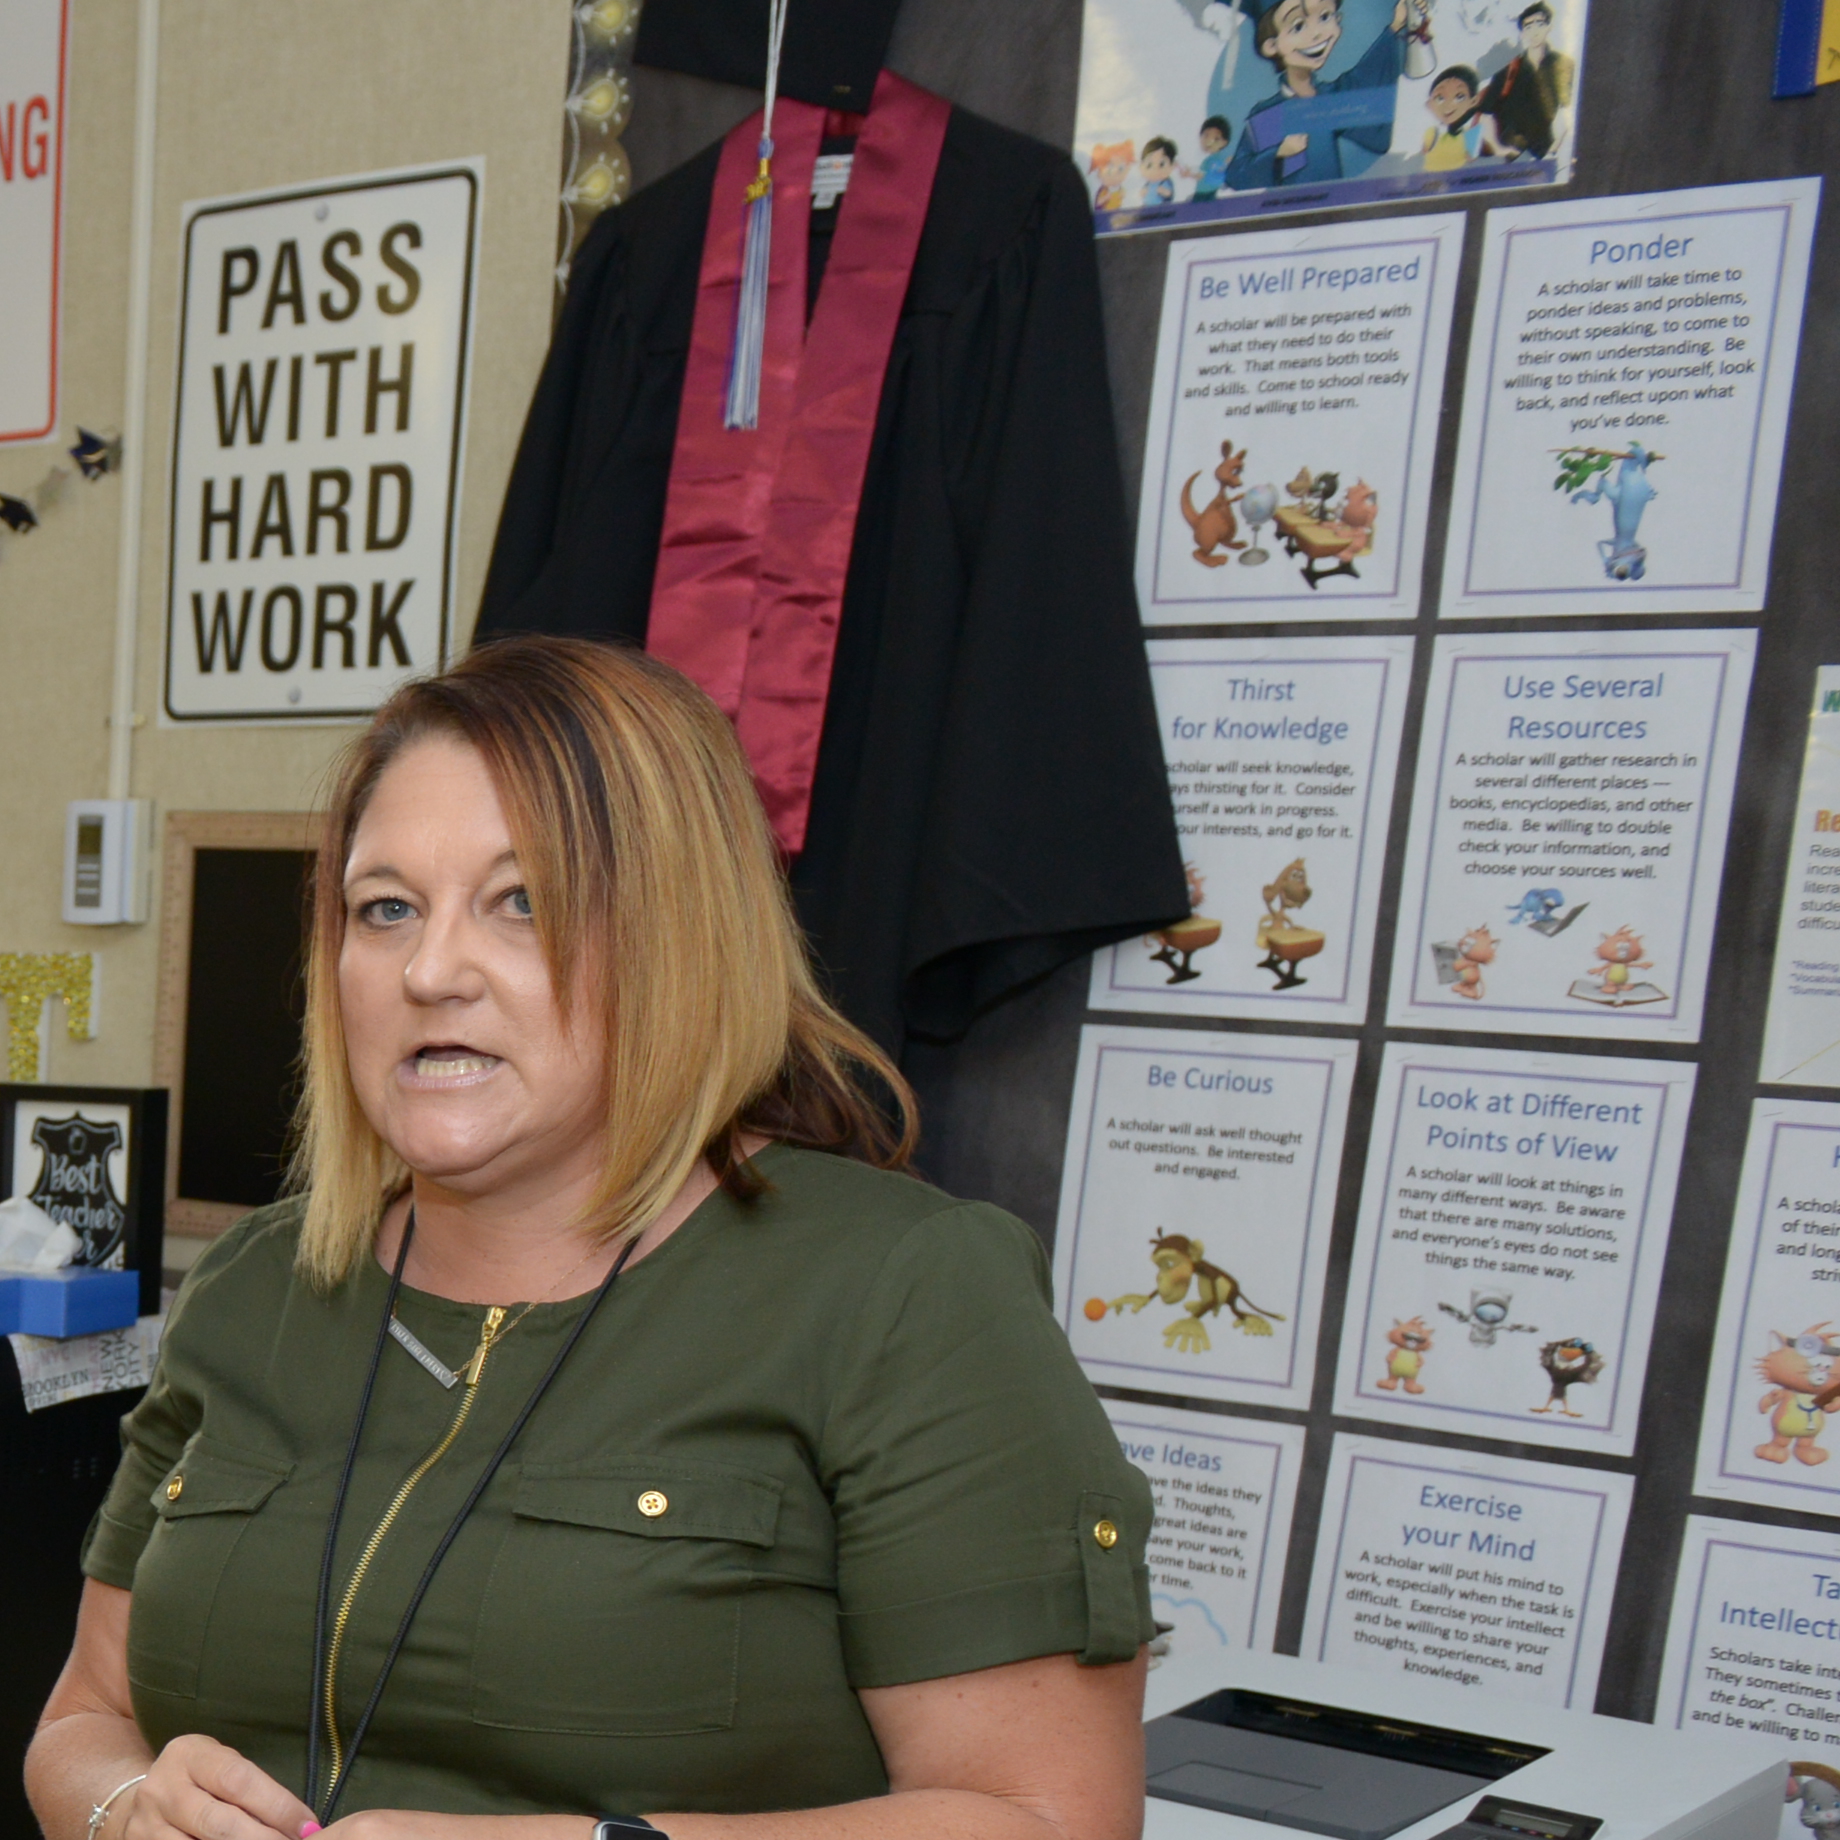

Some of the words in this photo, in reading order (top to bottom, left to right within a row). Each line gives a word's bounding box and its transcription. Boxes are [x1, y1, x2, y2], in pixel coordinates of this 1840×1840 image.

[1590, 233, 1694, 265] Ponder
[217, 221, 425, 336] PASS
[1200, 276, 1229, 299] Be
[1239, 268, 1295, 295] Well
[1302, 256, 1421, 292] Prepared
[1537, 283, 1550, 296] A
[1554, 278, 1612, 295] scholar
[1616, 274, 1643, 291] will
[1647, 272, 1680, 288] take
[1684, 270, 1721, 285] time
[1725, 267, 1742, 282] to
[1526, 302, 1584, 323] ponder
[1588, 299, 1629, 316] ideas
[1633, 296, 1663, 312] and
[1666, 291, 1747, 312] problems,
[212, 341, 418, 449] WITH
[1570, 414, 1621, 433] you've
[1625, 411, 1670, 427] done.
[198, 462, 414, 564] HARD
[190, 578, 418, 677] WORK
[1228, 677, 1296, 701] Thirst
[1505, 675, 1555, 699] Use
[1563, 672, 1665, 698] Several
[1172, 716, 1207, 740] for
[1213, 716, 1349, 745] Knowledge
[1508, 715, 1648, 739] Resources
[1148, 1065, 1177, 1087] Be
[1184, 1067, 1274, 1094] Curious
[1417, 1085, 1479, 1112] Look
[1486, 1093, 1514, 1114] at
[1522, 1093, 1643, 1125] Different
[1106, 1117, 1116, 1129] A
[1119, 1118, 1165, 1133] scholar
[1168, 1122, 1191, 1135] will
[1194, 1124, 1215, 1137] ask
[1219, 1127, 1245, 1140] well
[1249, 1129, 1303, 1146] thought
[1427, 1124, 1508, 1153] Points
[1516, 1132, 1546, 1155] of
[1551, 1135, 1619, 1162] View
[1109, 1139, 1130, 1150] out
[1134, 1139, 1200, 1156] questions.
[1207, 1145, 1223, 1158] Be
[1226, 1149, 1295, 1164] interested
[51, 1153, 102, 1194] Best
[1154, 1161, 1179, 1174] and
[1182, 1165, 1240, 1181] engaged.
[99, 1339, 113, 1388] NEW
[1120, 1441, 1155, 1461] ave
[1162, 1443, 1222, 1472] Ideas
[1420, 1485, 1522, 1521] Exercise
[1402, 1524, 1461, 1548] your
[1468, 1531, 1536, 1562] Mind
[1720, 1601, 1840, 1641] Intellect
[1709, 1646, 1775, 1669] Scholars
[1779, 1658, 1813, 1675] take
